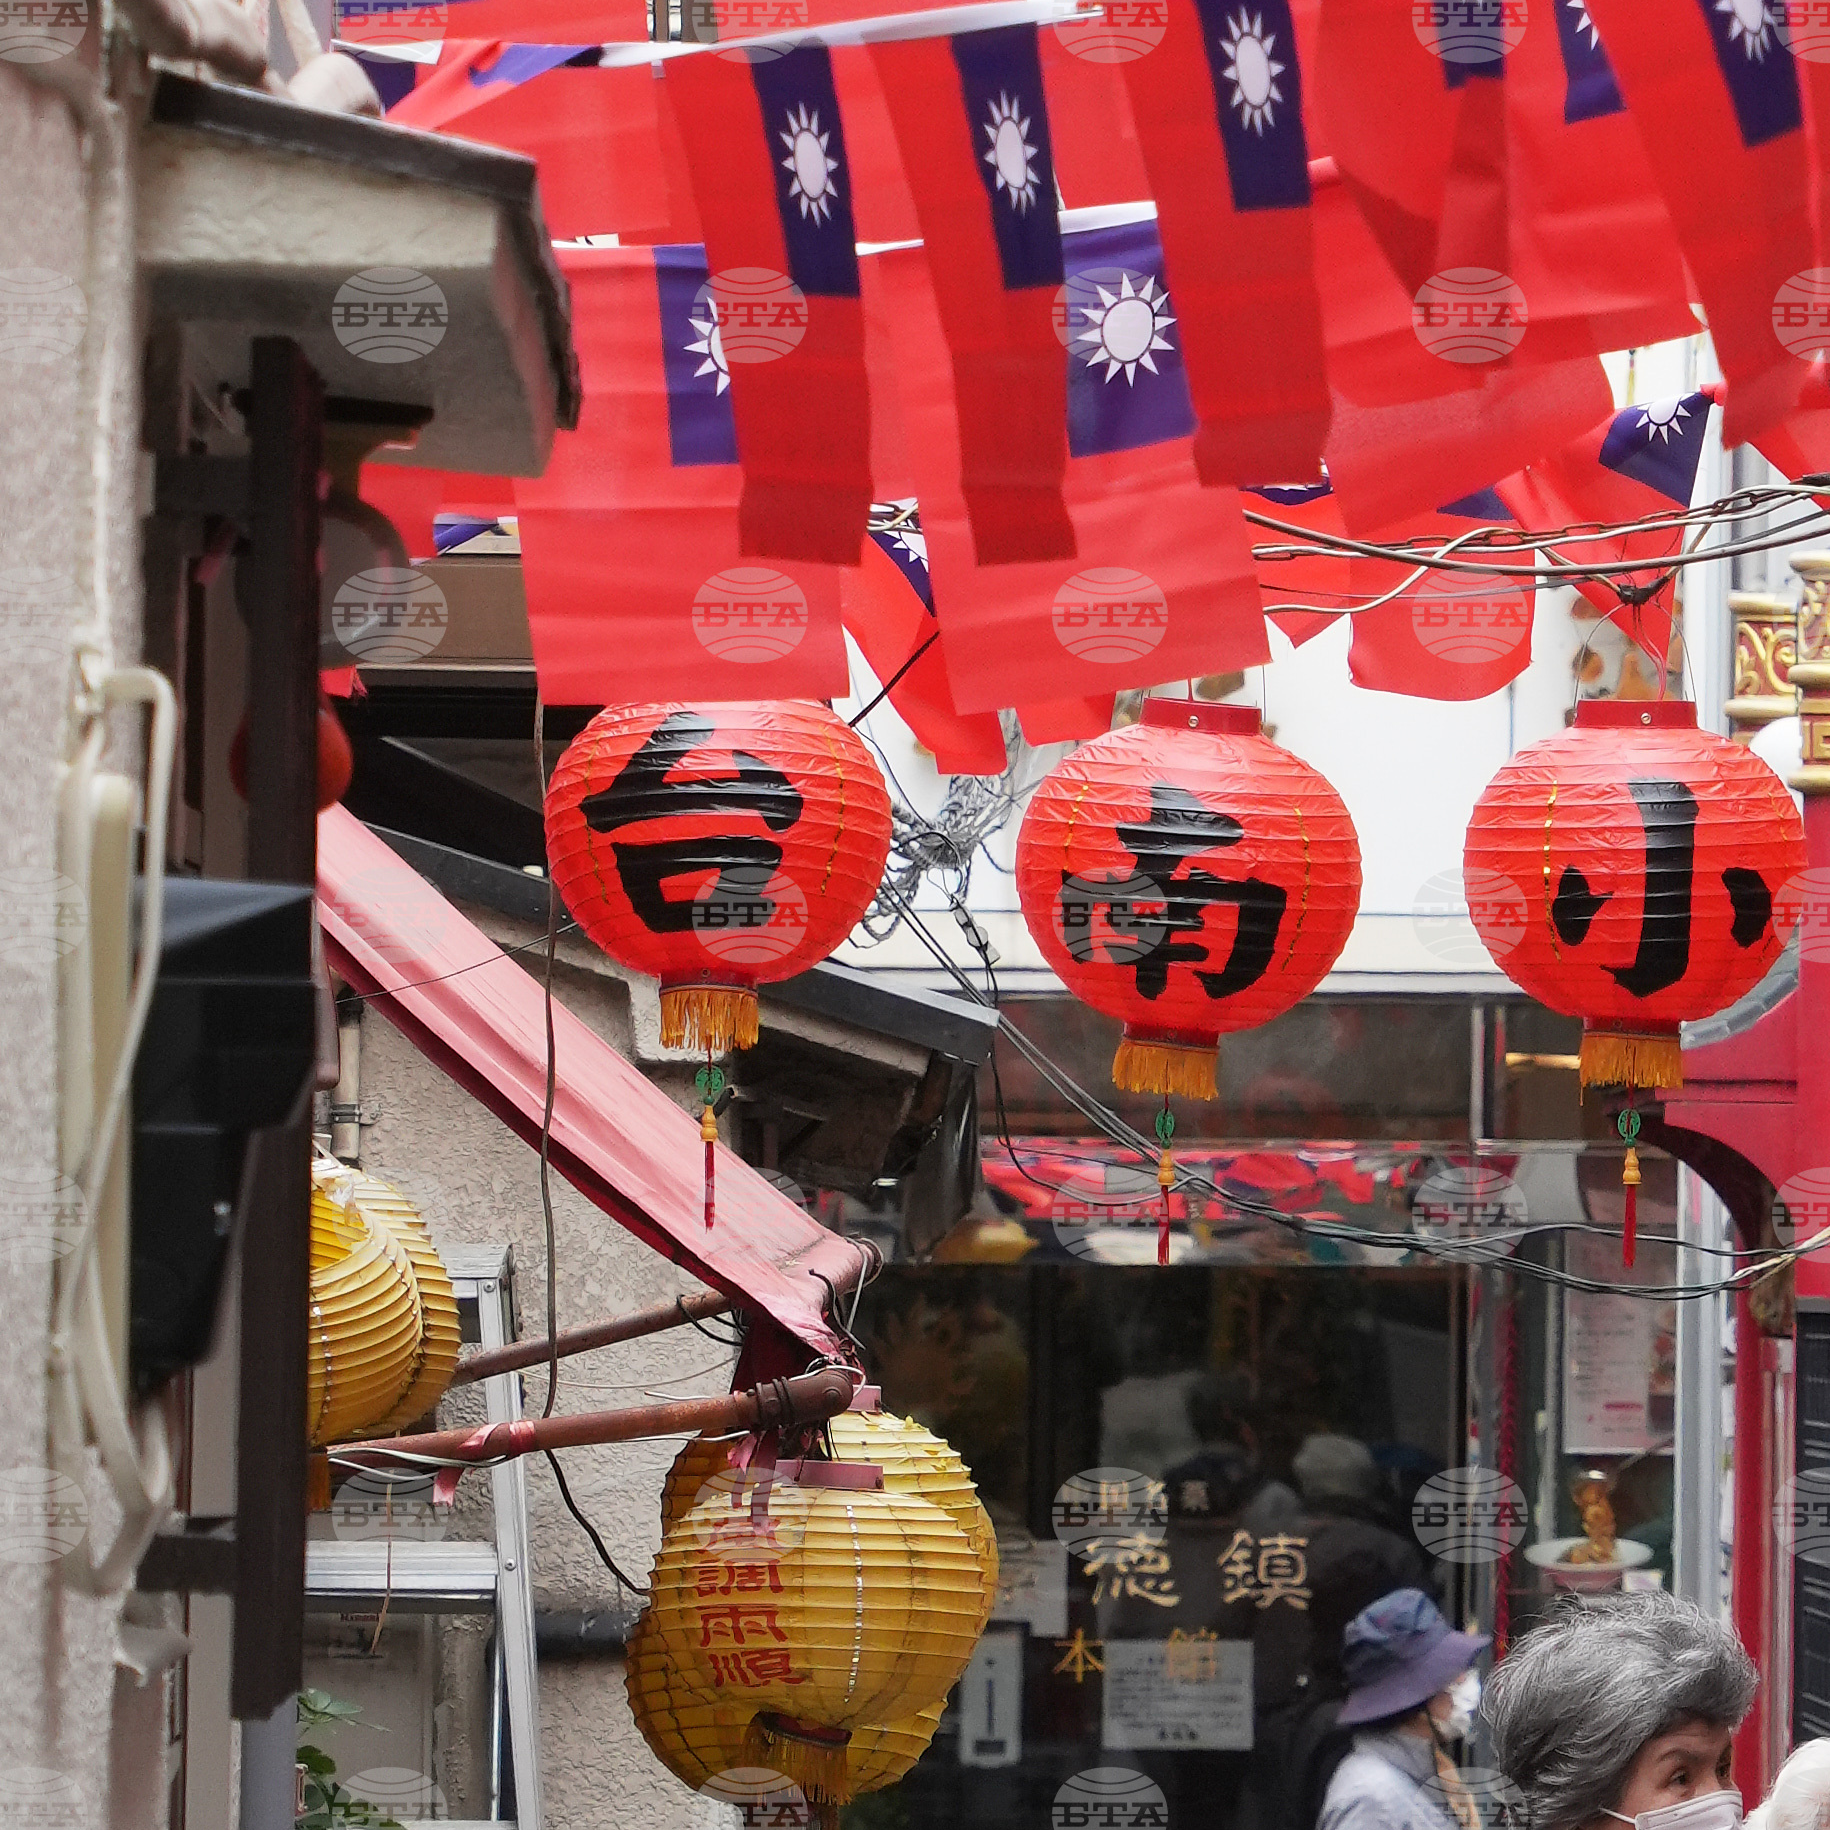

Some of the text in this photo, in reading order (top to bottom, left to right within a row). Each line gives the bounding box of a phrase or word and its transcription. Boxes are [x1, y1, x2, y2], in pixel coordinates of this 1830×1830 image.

[580, 711, 805, 934] 台
[1061, 782, 1287, 1001] 南
[1551, 776, 1773, 998] 小
